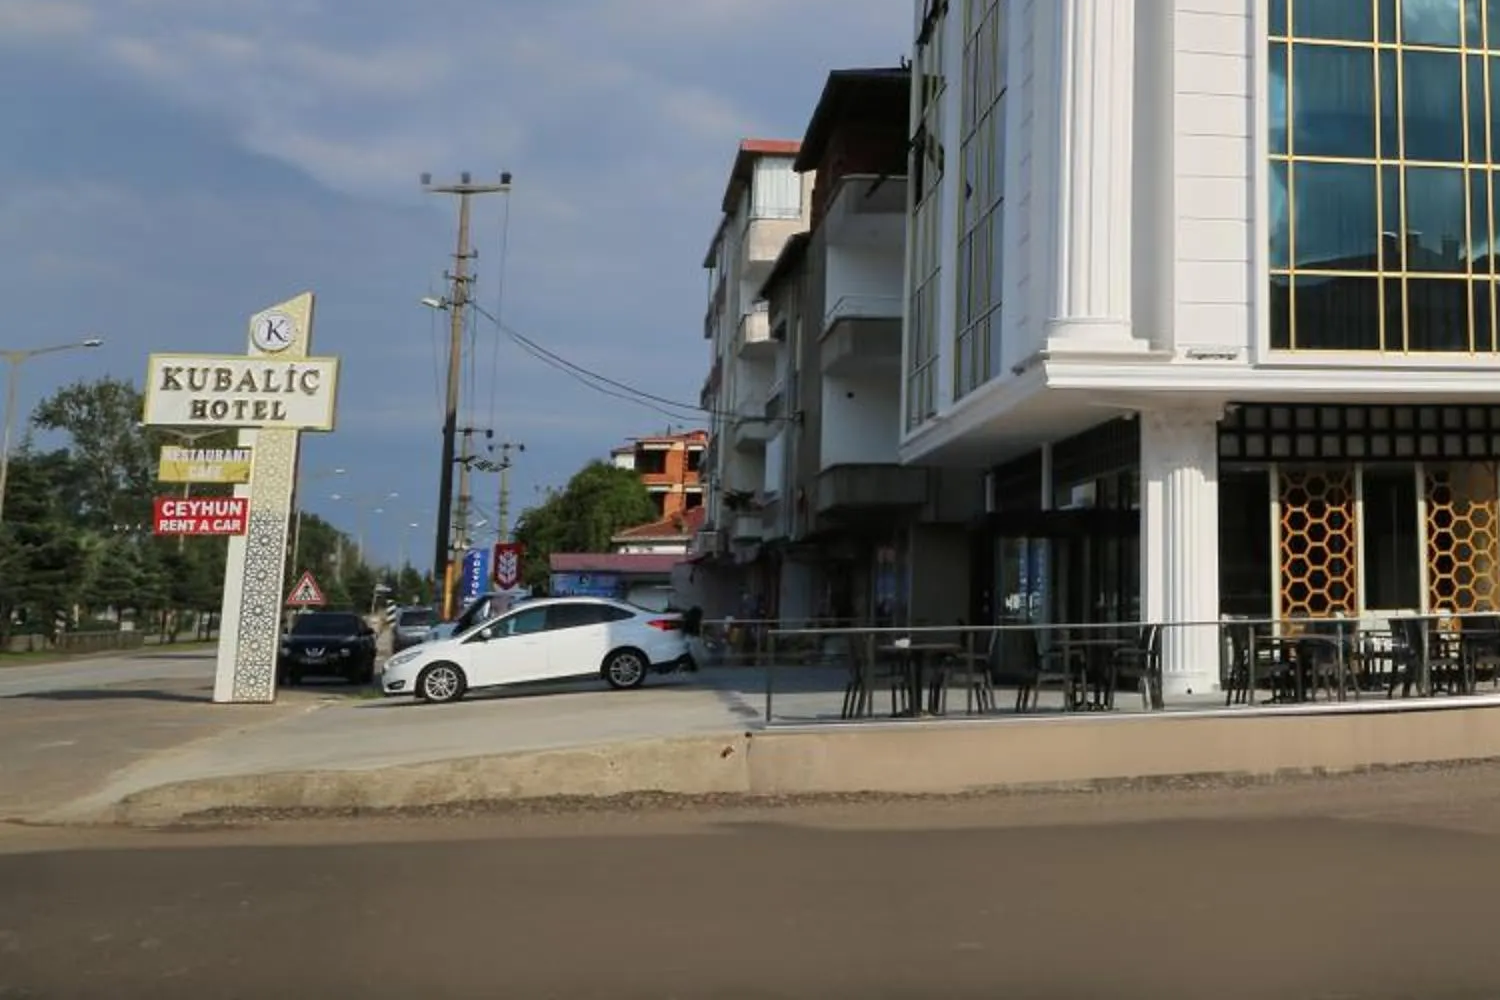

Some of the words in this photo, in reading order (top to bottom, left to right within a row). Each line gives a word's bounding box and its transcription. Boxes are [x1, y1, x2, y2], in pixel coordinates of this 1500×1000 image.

[266, 319, 287, 342] K
[160, 363, 320, 395] KUBALİÇ
[190, 399, 287, 420] HOTEL
[162, 501, 243, 516] CEYHUN
[160, 519, 197, 531] RENT
[200, 520, 210, 531] A
[213, 520, 241, 531] CAR
